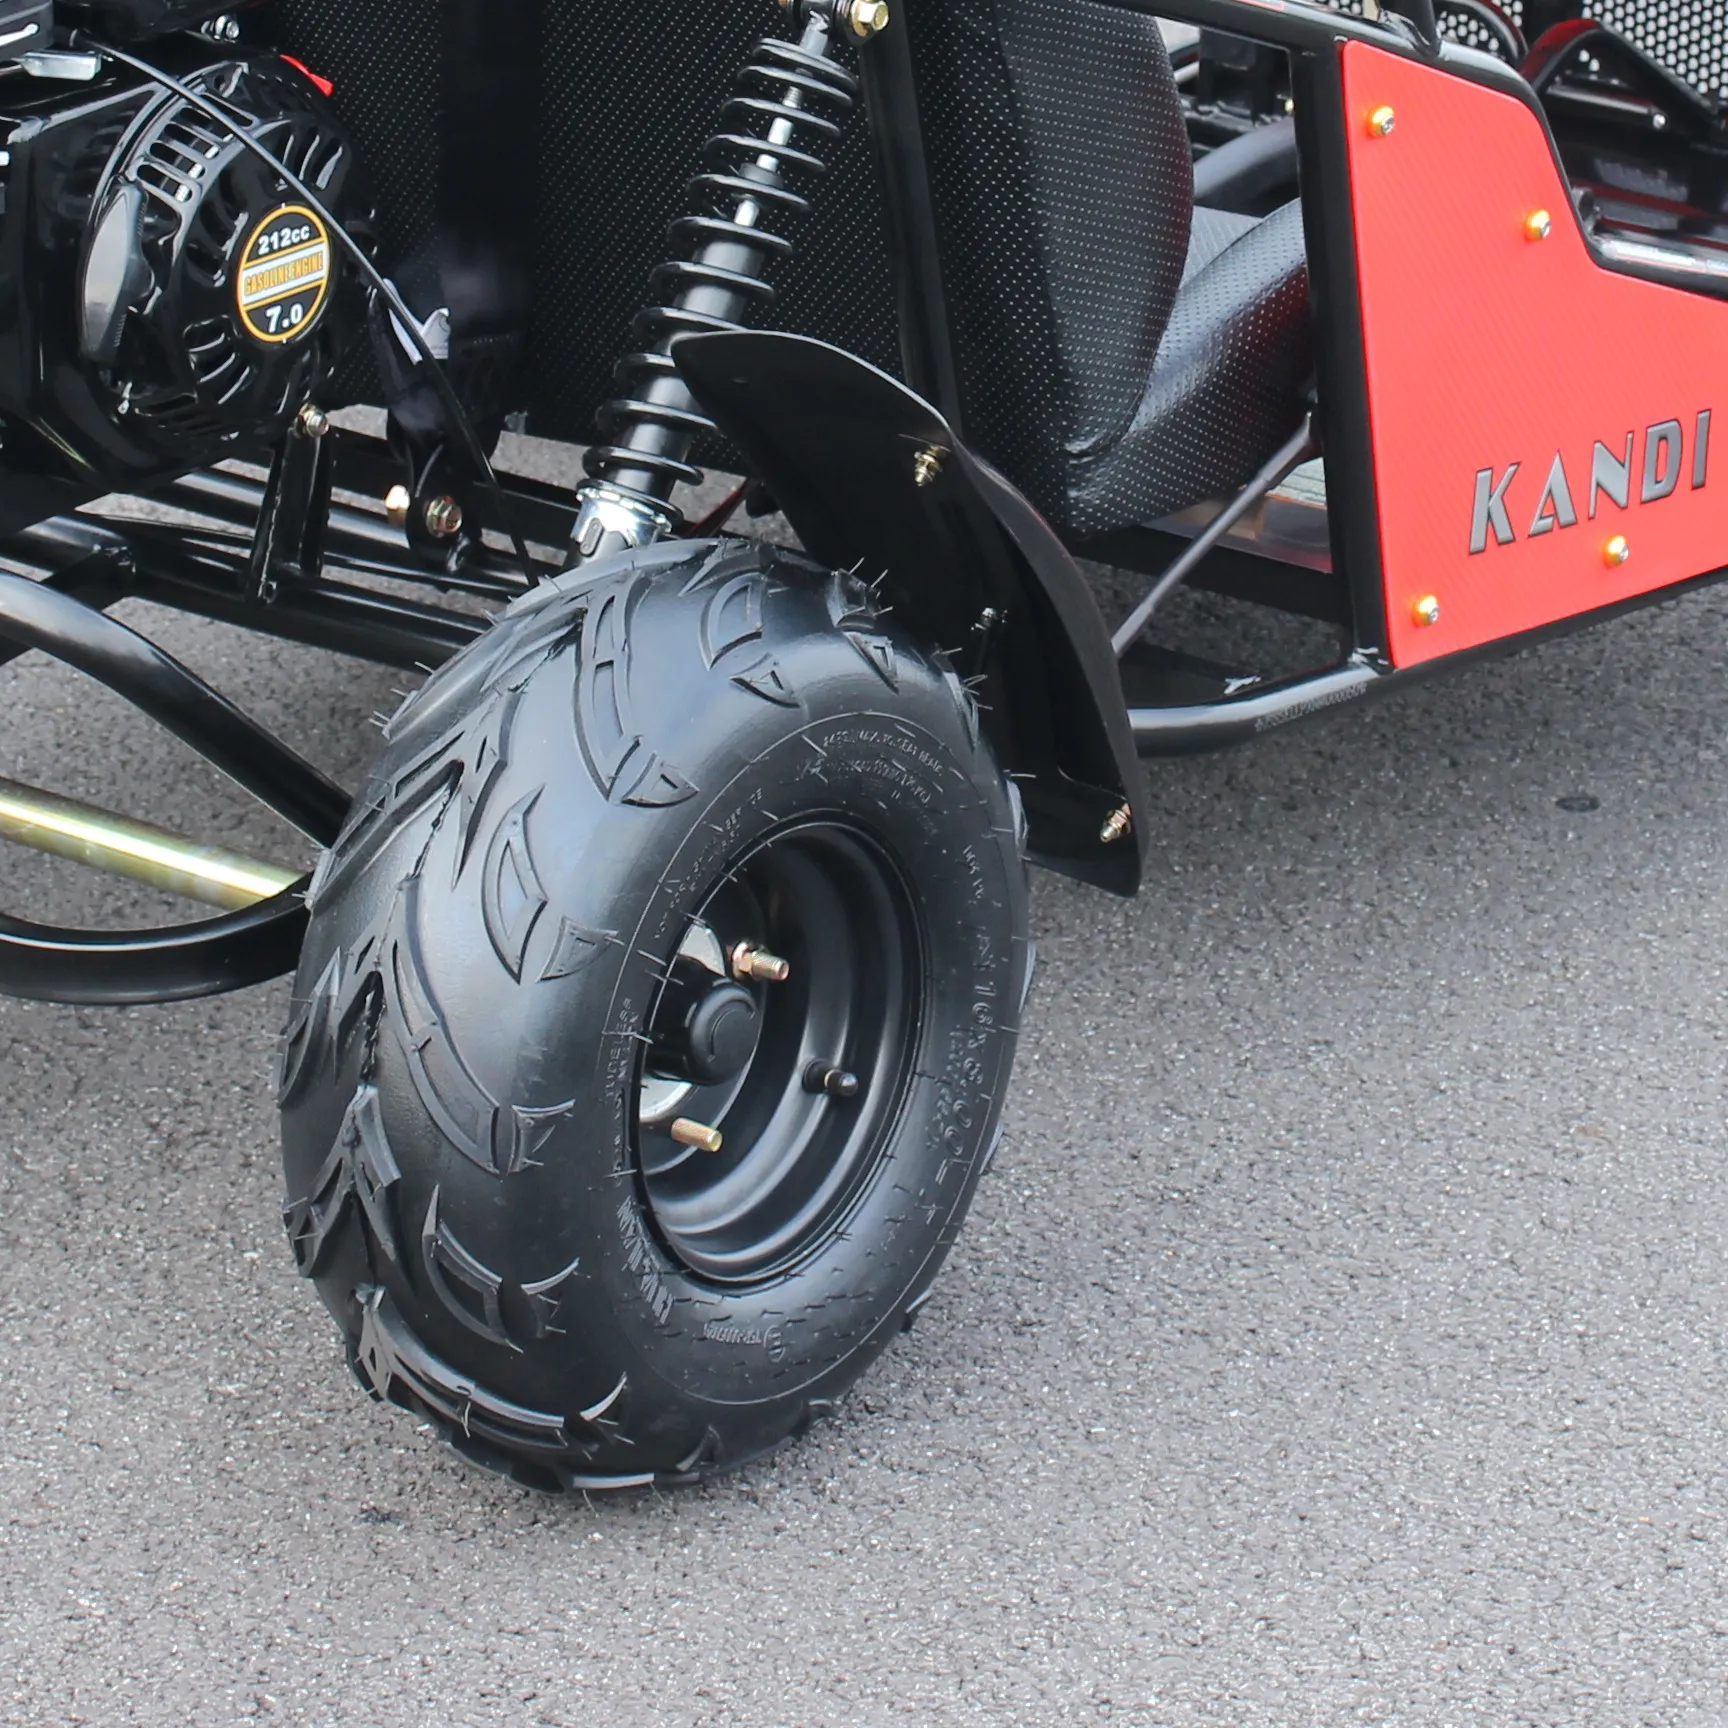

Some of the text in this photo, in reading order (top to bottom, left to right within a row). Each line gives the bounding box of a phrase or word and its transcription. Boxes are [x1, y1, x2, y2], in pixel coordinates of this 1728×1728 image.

[258, 225, 310, 255] 212cc
[245, 250, 324, 296] GASOLINE ENGINE
[265, 303, 304, 333] 7.0
[1468, 407, 1712, 556] KANDI
